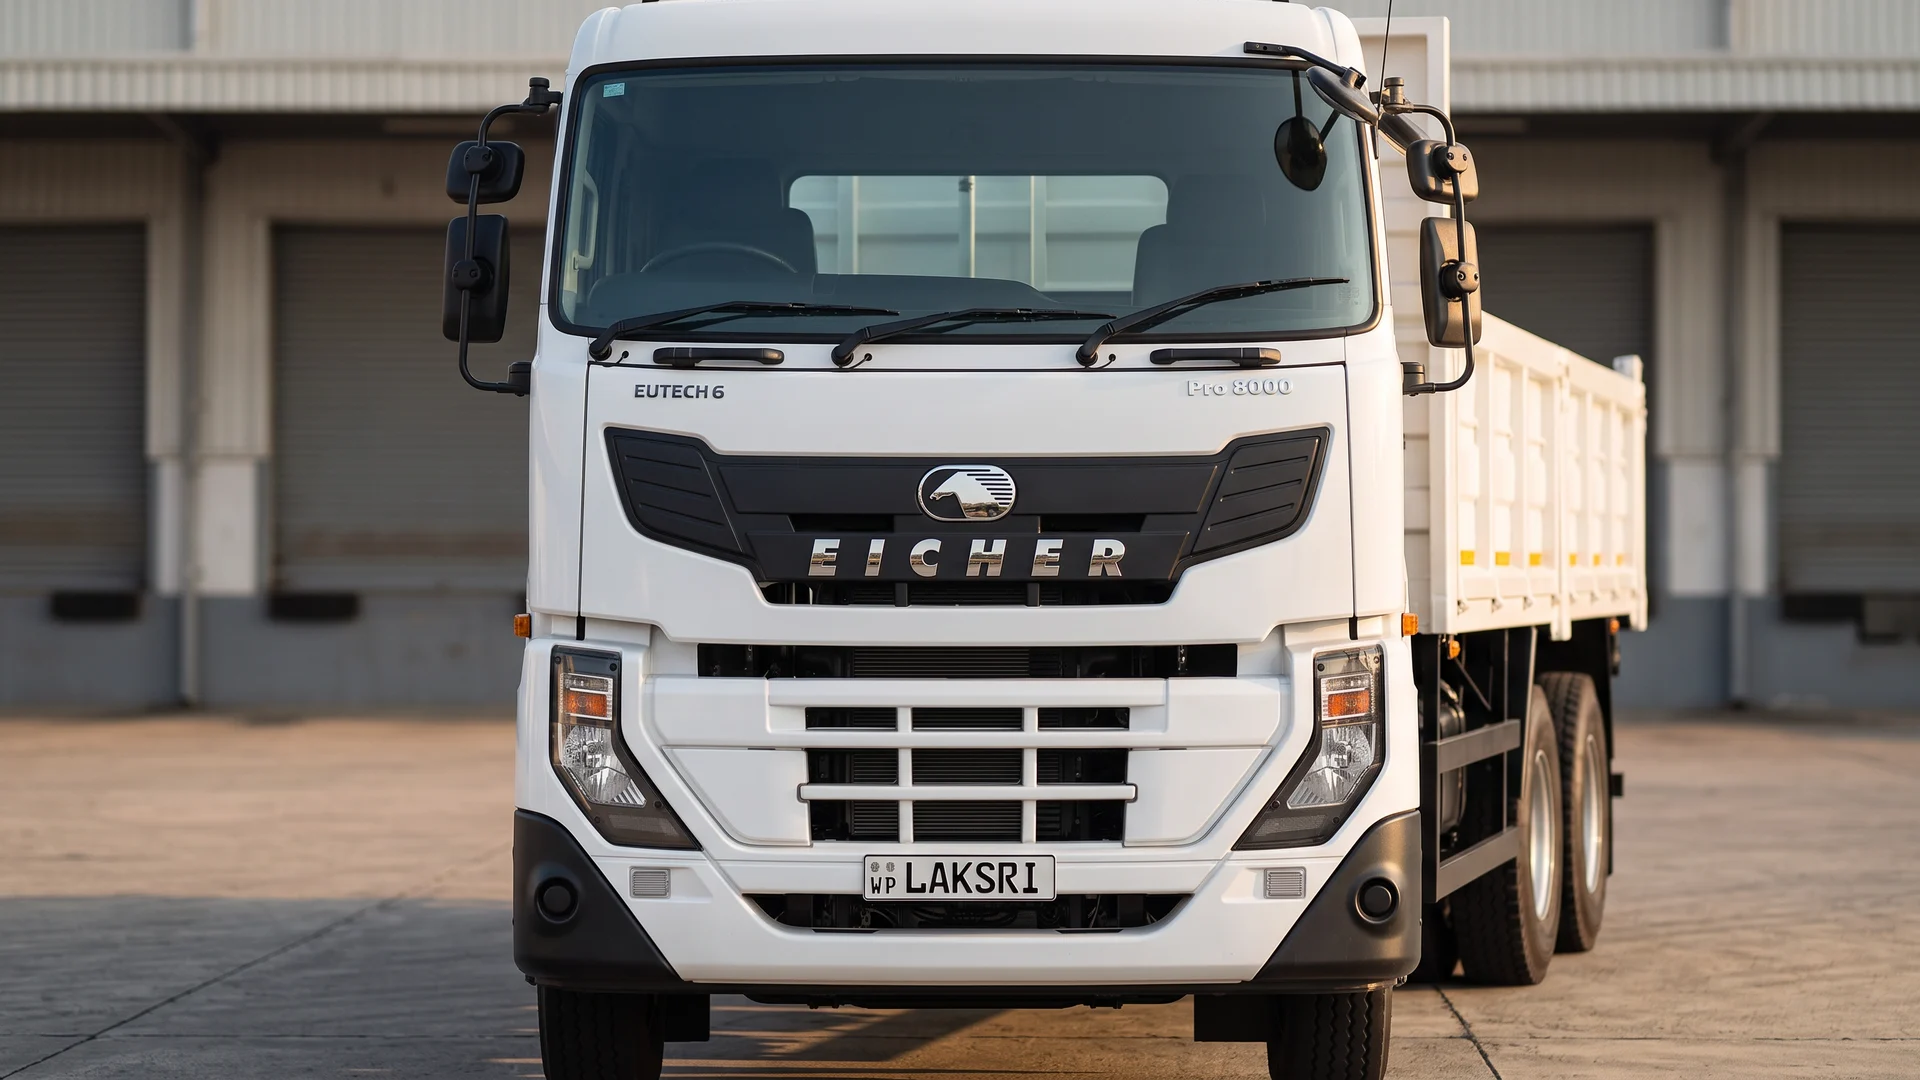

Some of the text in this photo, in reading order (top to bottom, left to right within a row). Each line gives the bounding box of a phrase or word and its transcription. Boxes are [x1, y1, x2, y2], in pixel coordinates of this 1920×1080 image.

[1187, 379, 1293, 396] Pro 8000
[808, 538, 1126, 578] EICHER
[870, 876, 896, 894] WP
[905, 861, 1039, 894] LAKSRI
